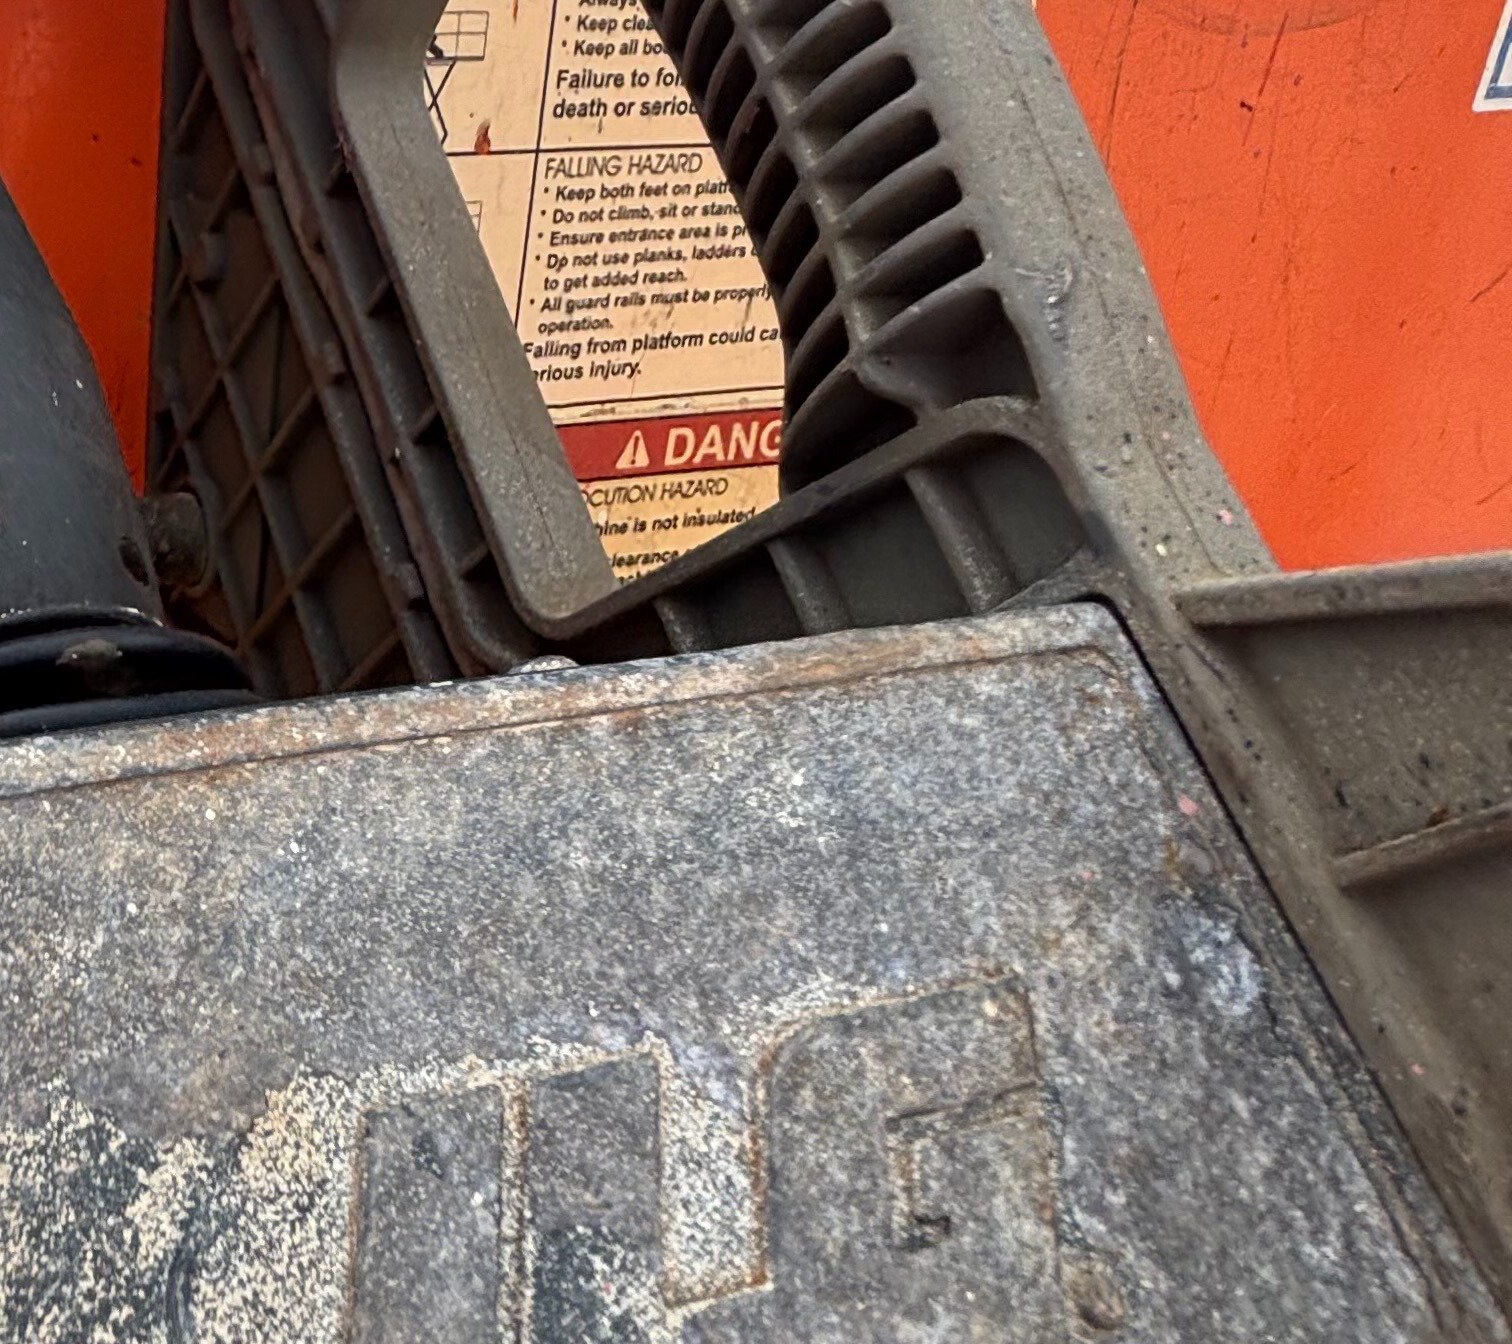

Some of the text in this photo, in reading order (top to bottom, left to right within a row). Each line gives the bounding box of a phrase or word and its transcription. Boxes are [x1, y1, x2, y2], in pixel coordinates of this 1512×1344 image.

[576, 14, 619, 35] Keep
[573, 38, 615, 60] Keep
[618, 38, 640, 56] all
[556, 67, 625, 90] Failure
[630, 70, 650, 88] to
[552, 97, 608, 119] death
[613, 100, 636, 117] or
[544, 151, 704, 180] FALLING HAZARD
[555, 185, 597, 204] Keep
[599, 181, 636, 199] both
[639, 181, 669, 197] feet
[672, 180, 692, 195] on
[552, 207, 575, 225] Do
[578, 207, 605, 224] not
[658, 203, 678, 219] sit
[680, 203, 699, 218] or
[549, 229, 604, 247] Ensure
[607, 225, 675, 244] entrance
[678, 225, 711, 241] area
[714, 222, 729, 237] is
[546, 253, 569, 269] Do
[572, 251, 598, 268] not
[601, 250, 631, 266] use
[633, 245, 688, 267] planks,
[691, 243, 747, 261] ladders
[543, 267, 688, 293] to get added reach.
[540, 296, 562, 314] All
[565, 293, 610, 315] guard
[614, 291, 647, 307] rails
[650, 288, 689, 305] must
[691, 287, 711, 303] be
[537, 316, 614, 335] operation.
[585, 335, 628, 356] from
[630, 330, 704, 354] platform
[708, 325, 756, 346] could
[588, 359, 643, 380] injury.
[659, 476, 729, 501] HAZARD
[632, 516, 647, 533] is
[651, 513, 679, 532] not
